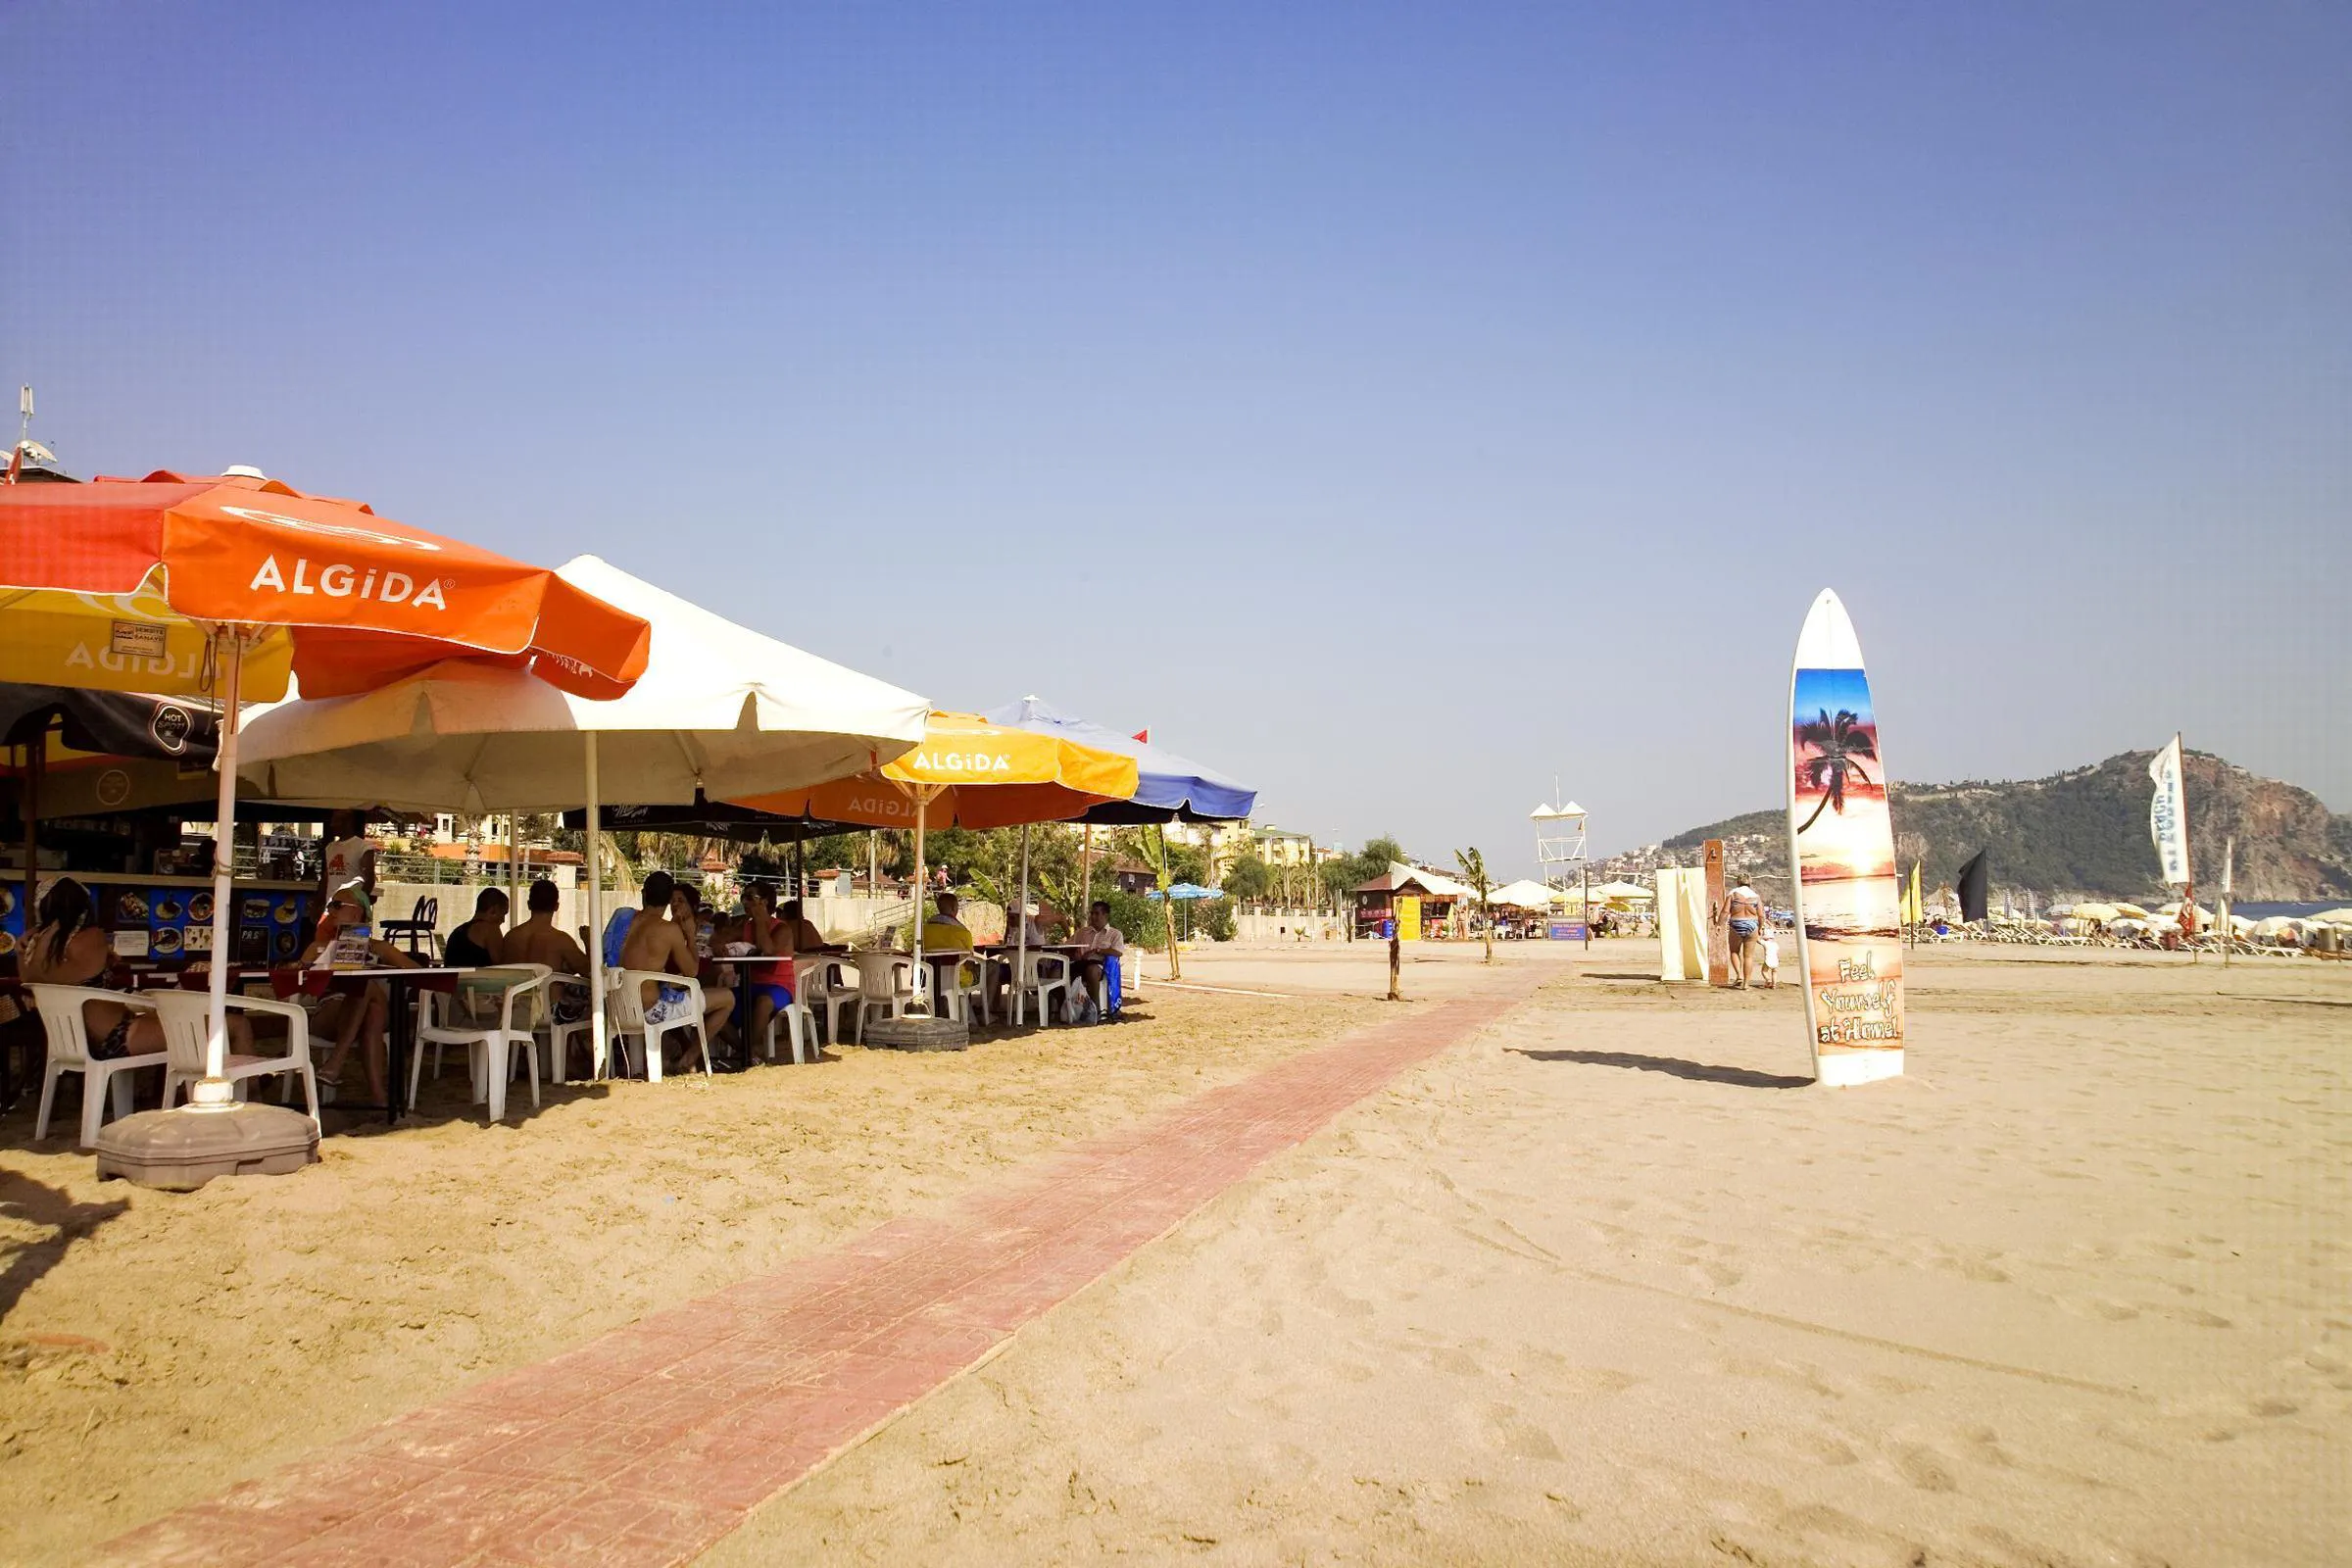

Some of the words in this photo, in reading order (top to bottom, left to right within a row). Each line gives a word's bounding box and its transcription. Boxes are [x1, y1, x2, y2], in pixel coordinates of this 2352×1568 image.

[250, 554, 446, 611] ALGiDA
[164, 713, 182, 722] HOT
[912, 752, 1010, 770] ALGiDA
[1838, 950, 1876, 983] Feel
[1820, 979, 1896, 1018] Yourself
[1820, 1016, 1840, 1043] at
